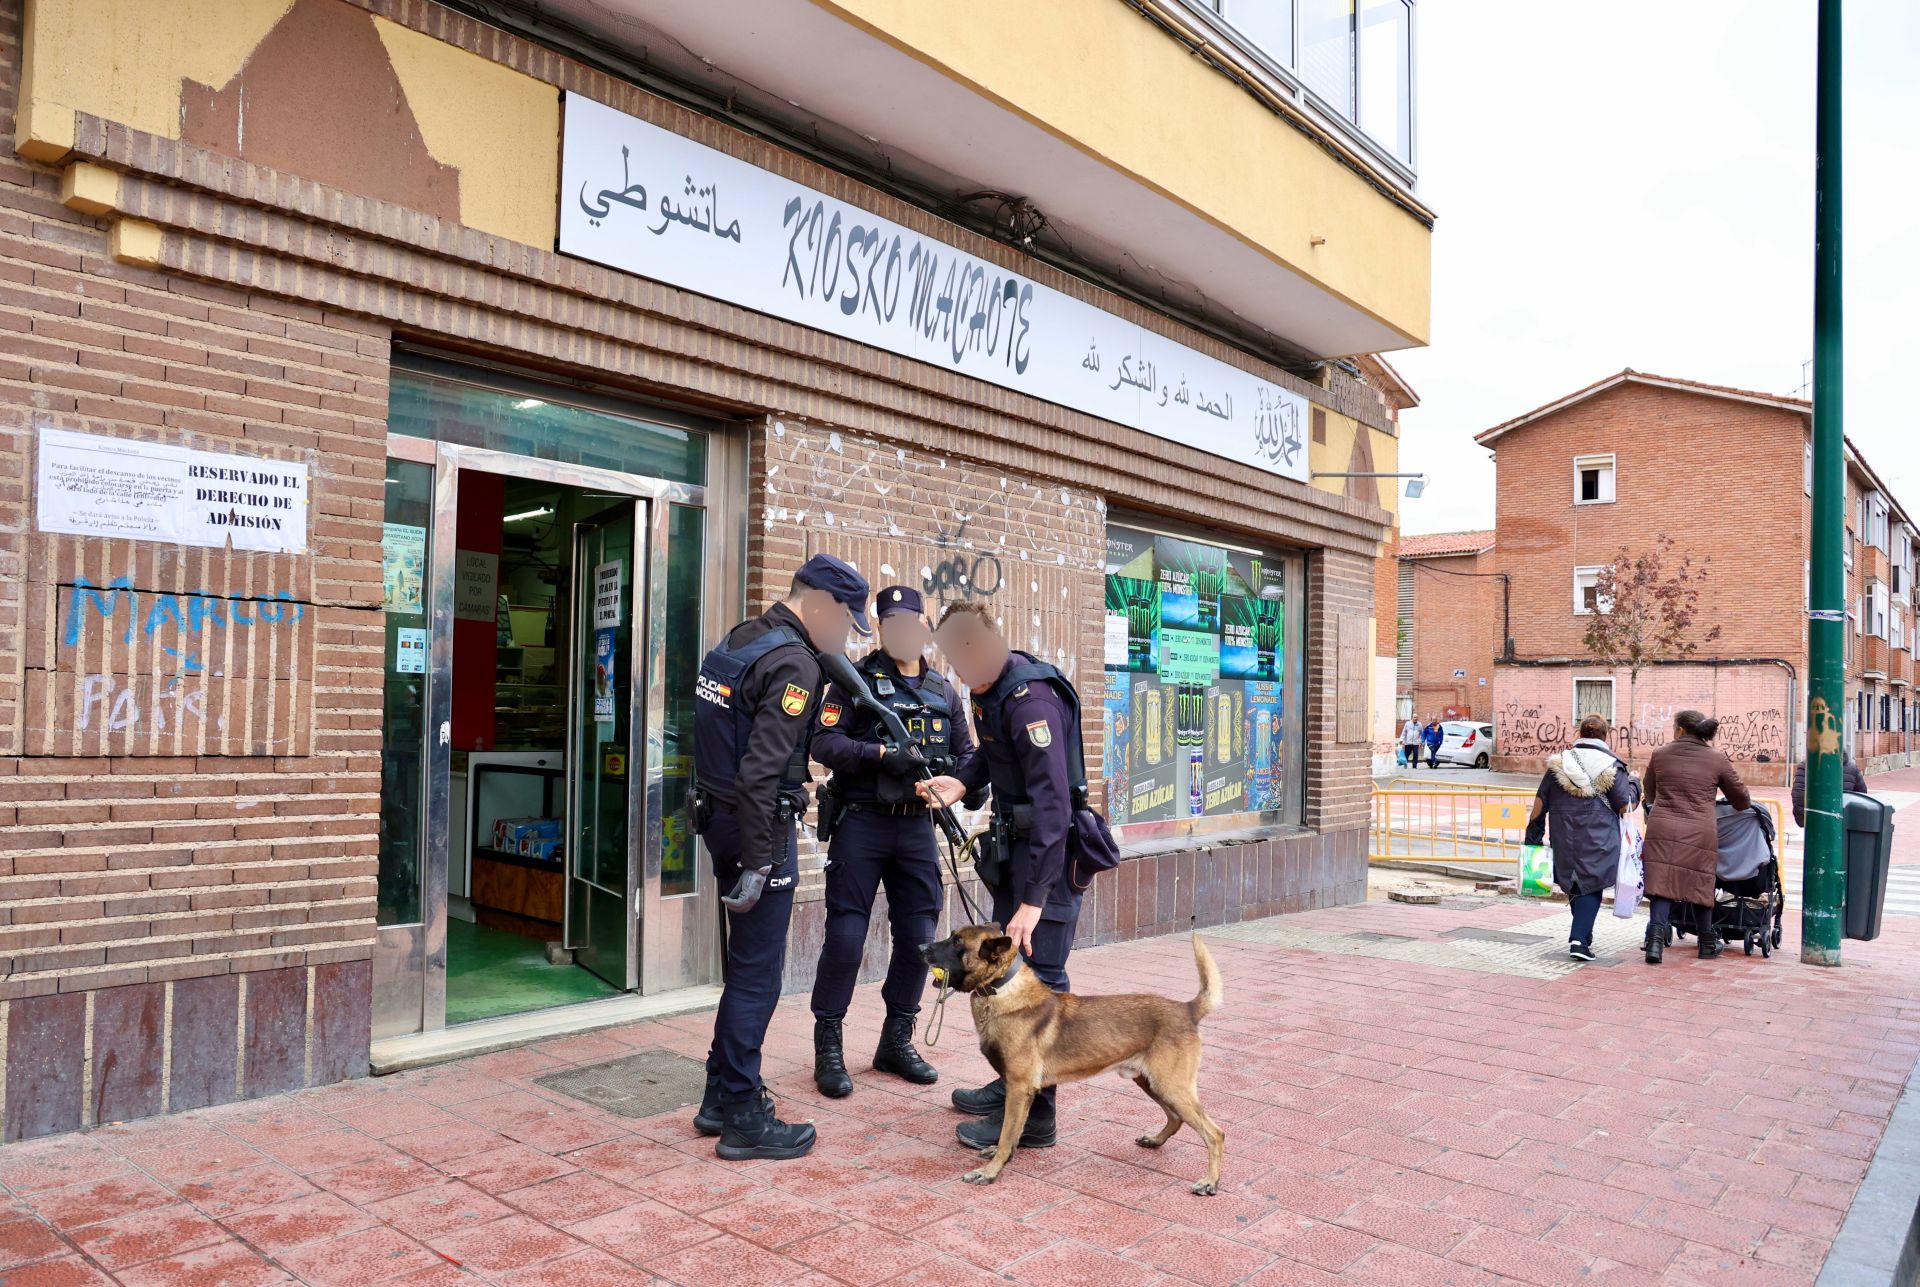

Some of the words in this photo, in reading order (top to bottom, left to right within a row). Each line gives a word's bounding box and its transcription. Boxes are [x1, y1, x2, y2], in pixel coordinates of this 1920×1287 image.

[782, 194, 902, 326] KIOSKO
[908, 240, 1034, 376] MACHOTE
[1082, 335, 1101, 373] لله
[1108, 355, 1157, 392] الشكر
[1196, 390, 1233, 422] الحمد
[51, 462, 68, 470] Para
[69, 464, 96, 474] facilitar
[105, 468, 136, 478] descanso
[157, 475, 181, 484] vecinos
[188, 464, 279, 486] RESERVADO
[283, 475, 300, 489] EL
[65, 476, 100, 487] prohibido
[100, 481, 132, 490] colocarse
[150, 485, 172, 495] puerta
[196, 487, 269, 508] DERECHO
[273, 496, 292, 510] DE
[1106, 538, 1134, 553] ONSTER
[466, 557, 487, 569] LOCAL
[462, 571, 490, 584] VIGILADO
[1160, 569, 1172, 581] ZERO
[469, 586, 482, 597] POR
[64, 575, 305, 647] MARCOS
[1224, 623, 1235, 635] ZERO
[1105, 675, 1117, 685] SIE
[694, 685, 730, 709] NACIONAL
[1104, 689, 1123, 700] NADE
[1250, 695, 1279, 704] LEMONADE
[1131, 794, 1149, 816] ZERO
[1149, 783, 1175, 809] AZÚCAR
[1205, 789, 1221, 811] ZERO
[1220, 781, 1242, 805] AZÚCAR
[770, 876, 792, 887] CNP
